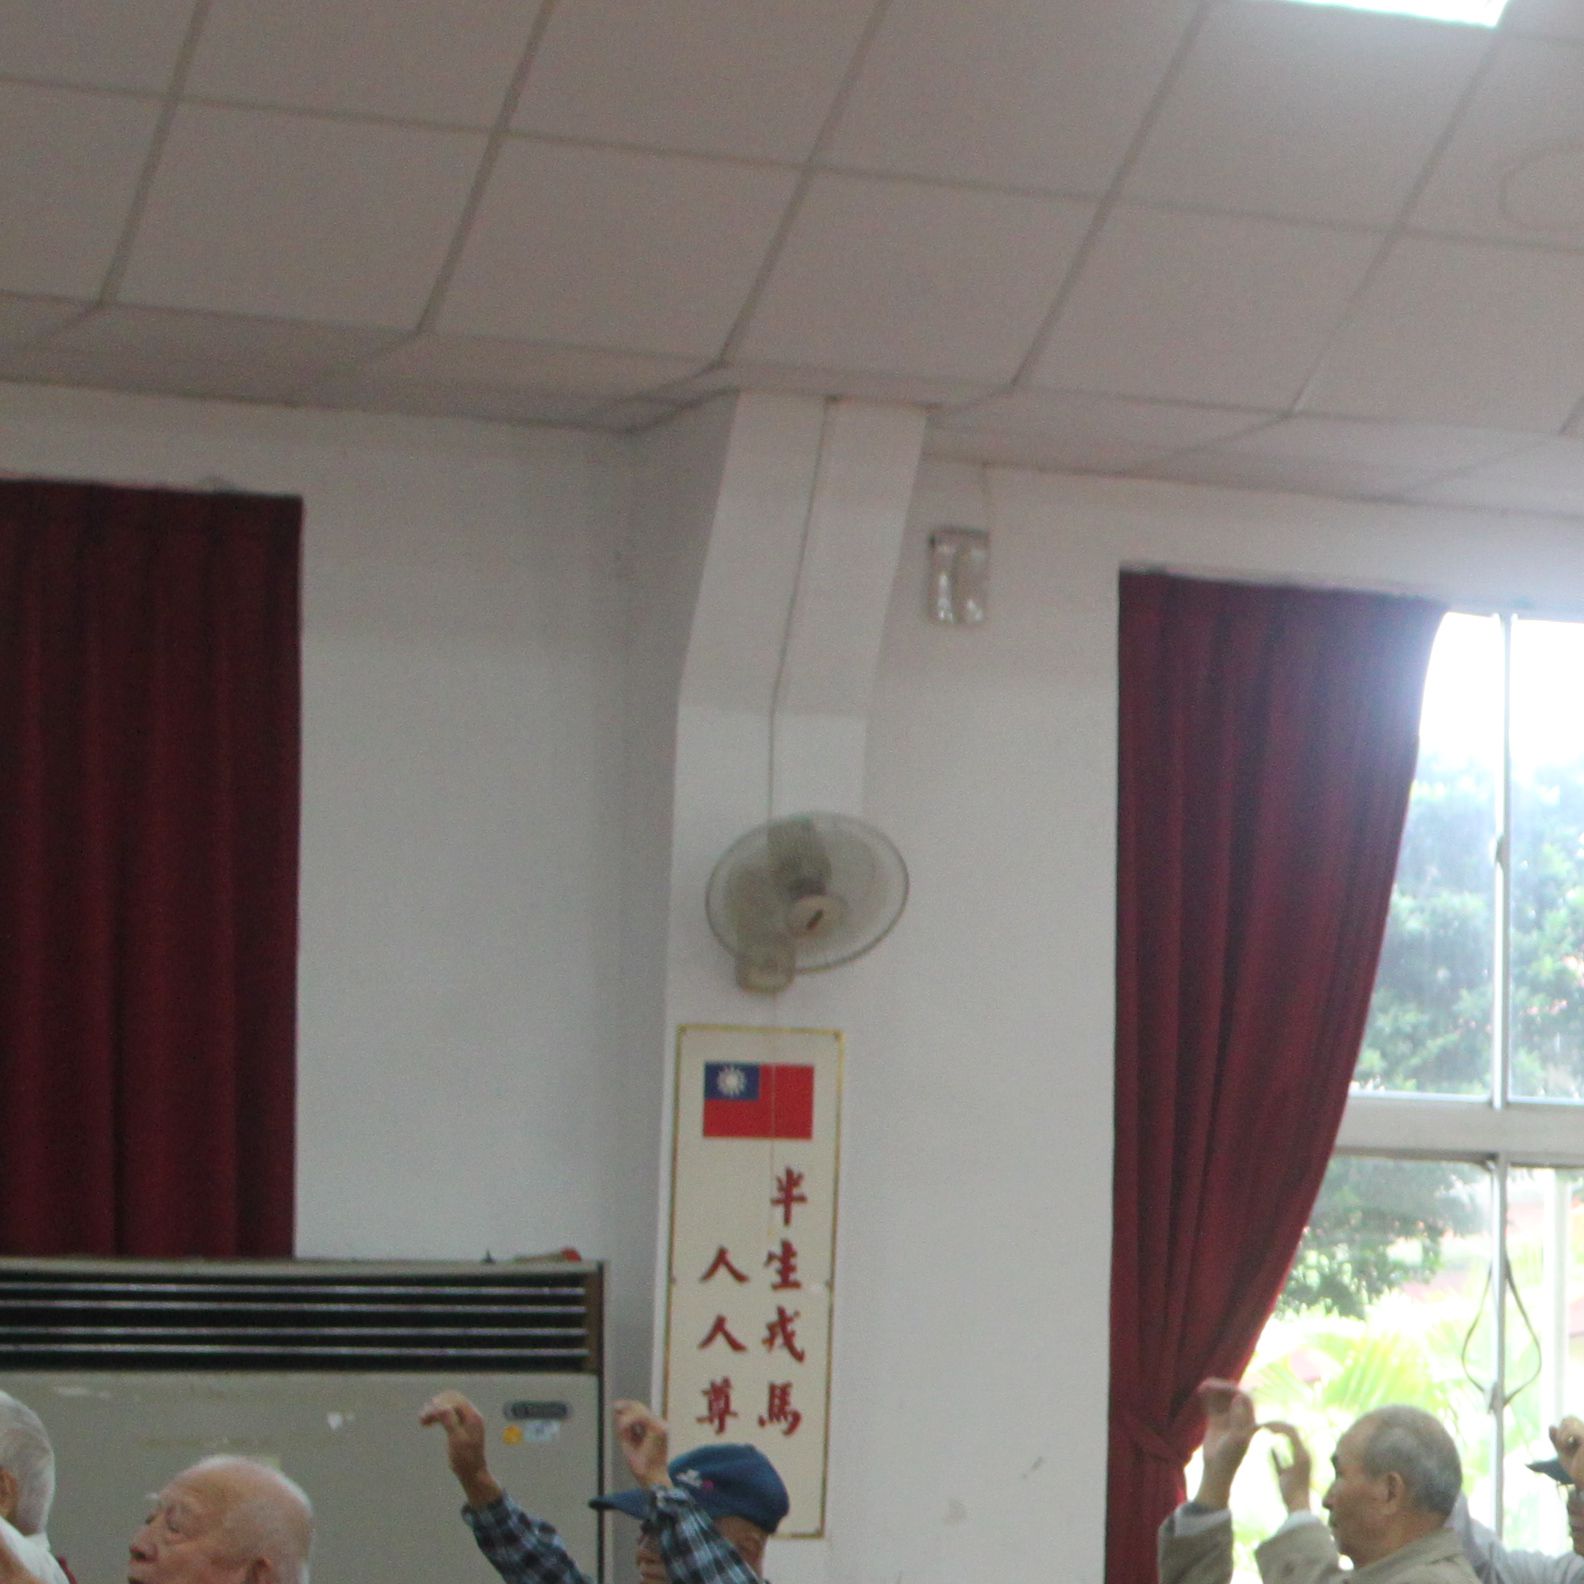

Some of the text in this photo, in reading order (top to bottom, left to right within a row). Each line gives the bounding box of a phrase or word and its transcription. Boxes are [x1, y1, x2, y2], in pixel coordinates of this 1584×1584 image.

[696, 1245, 751, 1435] 人人尊
[758, 1166, 808, 1437] 半生戎馬
